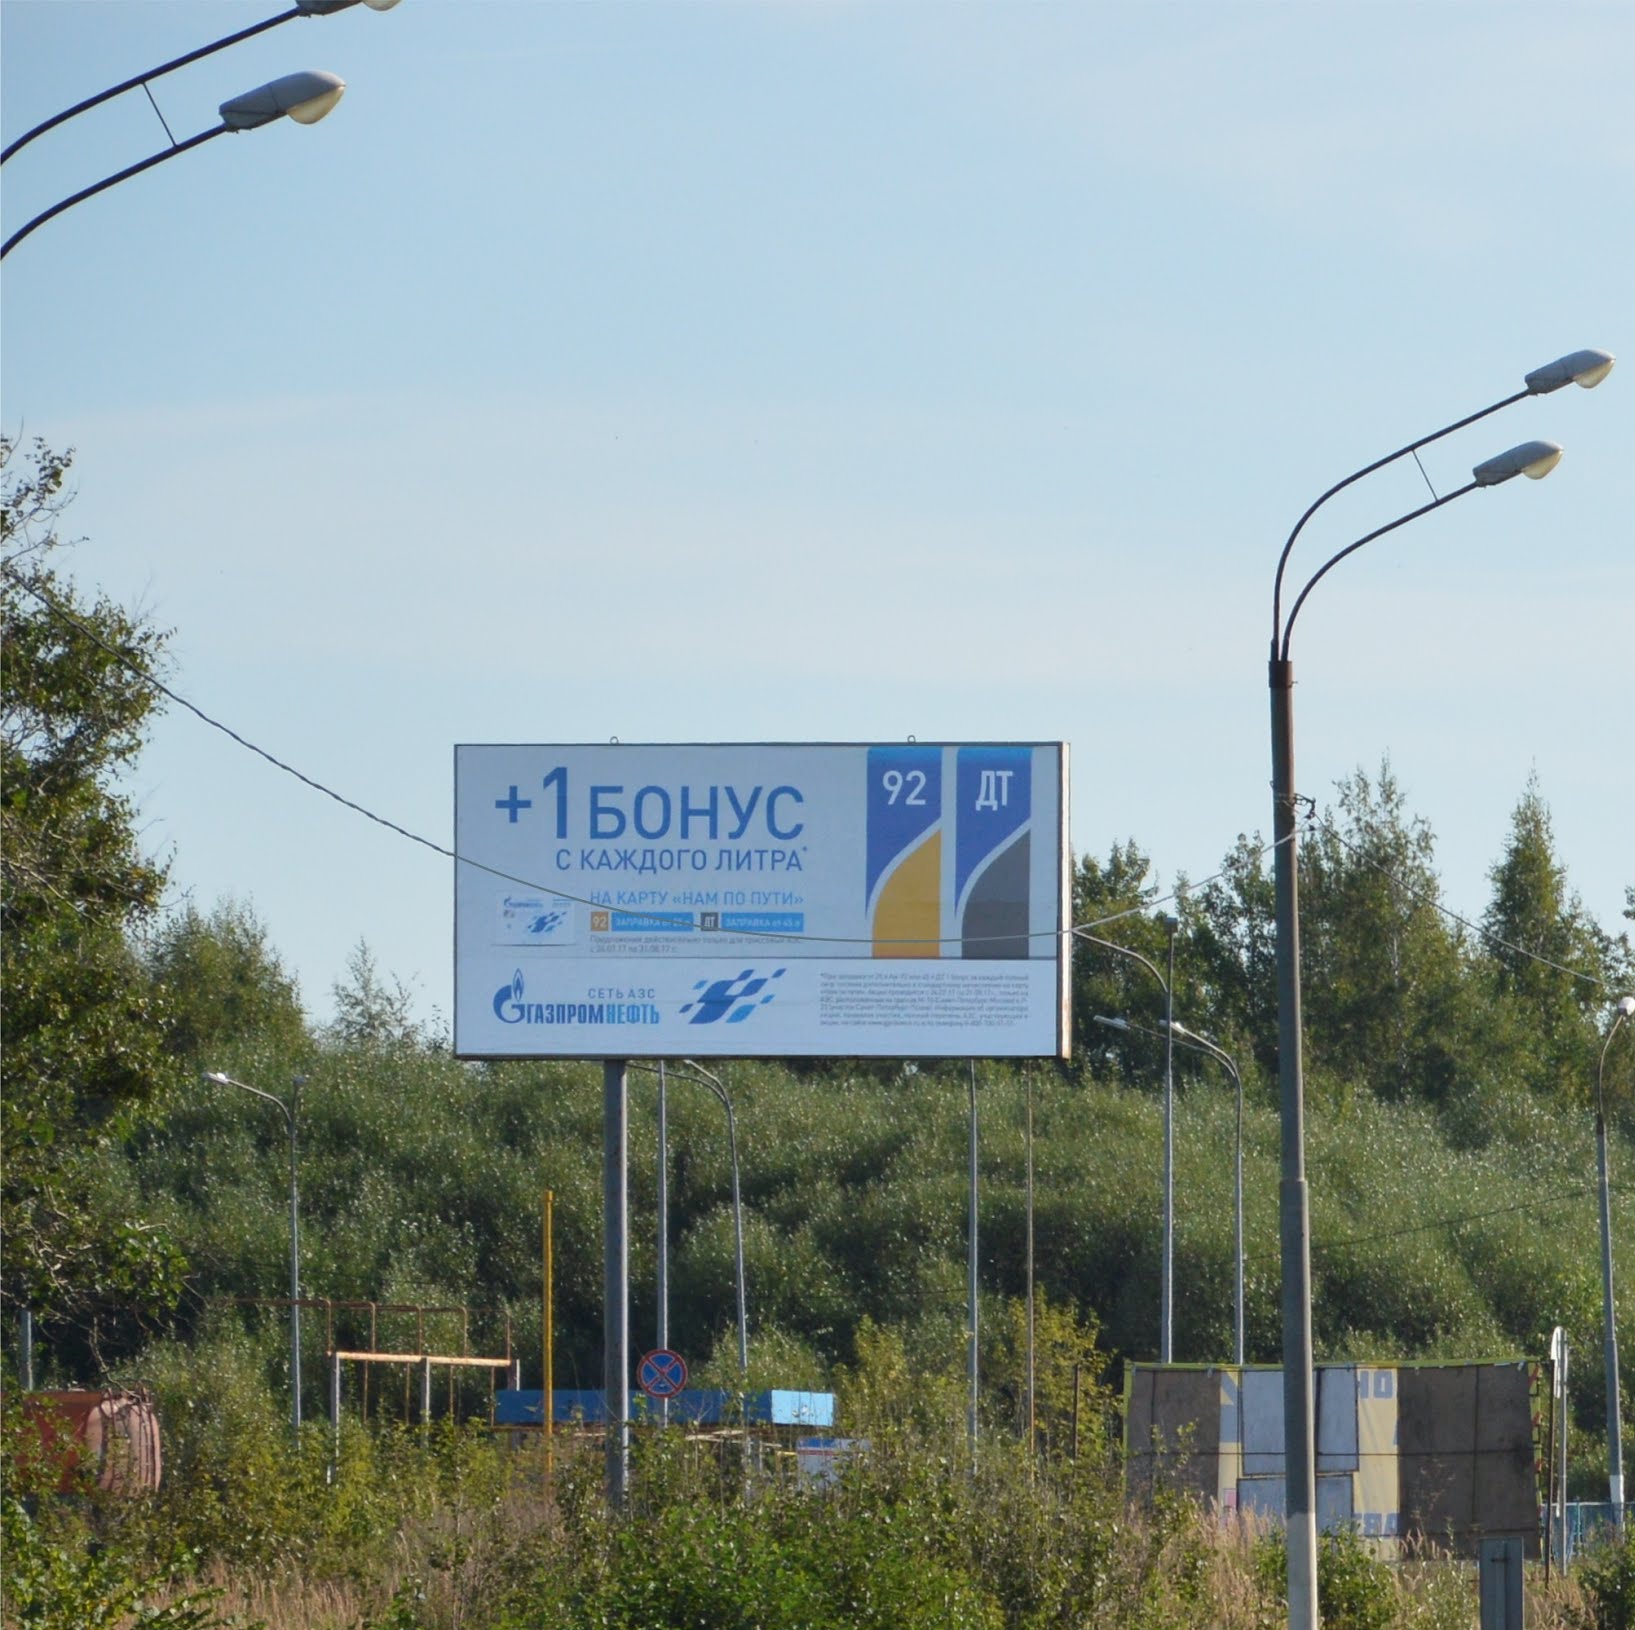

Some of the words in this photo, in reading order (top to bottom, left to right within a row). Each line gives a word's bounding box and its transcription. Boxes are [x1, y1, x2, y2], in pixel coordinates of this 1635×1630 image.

[882, 769, 927, 806] 92
[975, 769, 1014, 812] ДТ
[589, 785, 804, 841] БОНУС
[555, 849, 571, 871] С
[580, 849, 708, 875] КАЖДОГО
[590, 891, 612, 906] НА
[617, 891, 669, 906] КАРТУ
[723, 891, 746, 906] ПО
[592, 915, 608, 929] 92
[703, 916, 716, 929] ДТ
[588, 988, 626, 1000] СЕТЬ
[628, 988, 656, 1000] АЗС
[526, 1003, 661, 1025] ГАЗПРОМНЕФТЬ
